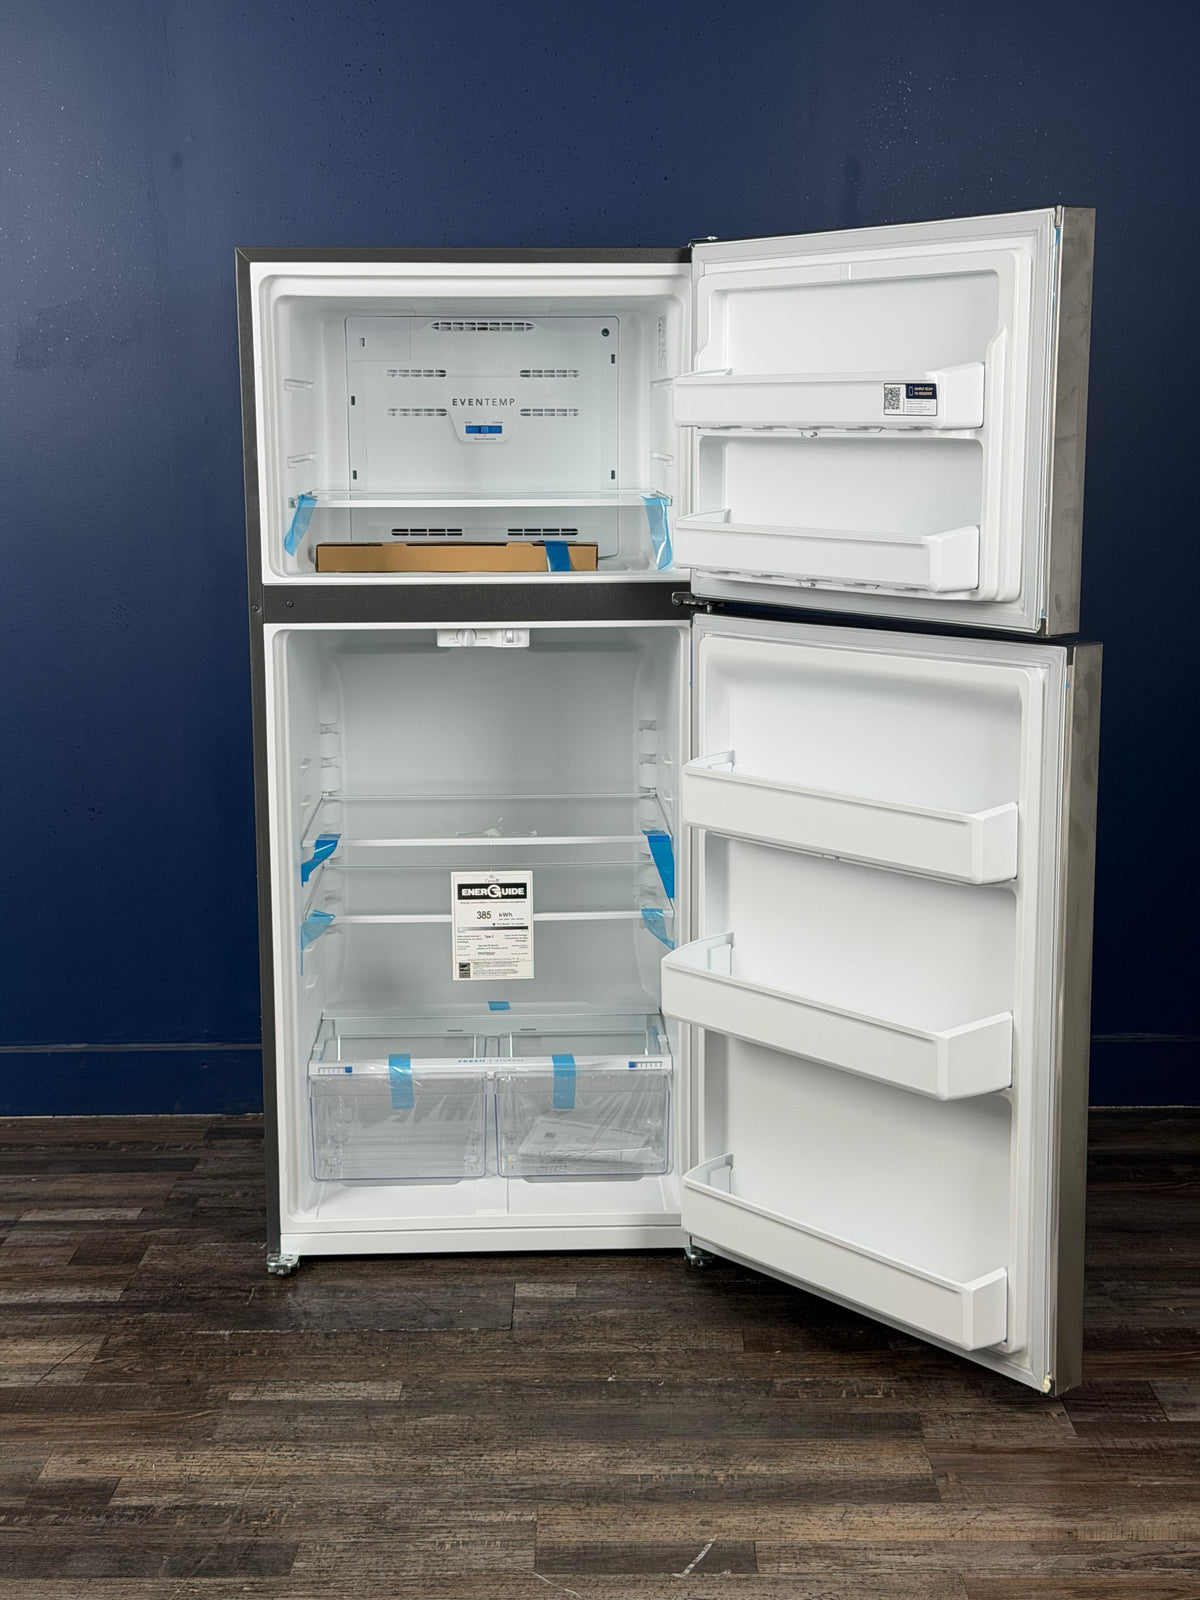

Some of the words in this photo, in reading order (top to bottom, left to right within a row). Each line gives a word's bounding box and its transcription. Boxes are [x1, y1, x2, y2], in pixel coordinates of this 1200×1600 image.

[452, 398, 516, 406] EVENTEMP
[461, 884, 525, 898] ENERGUIDE
[476, 910, 492, 920] 385
